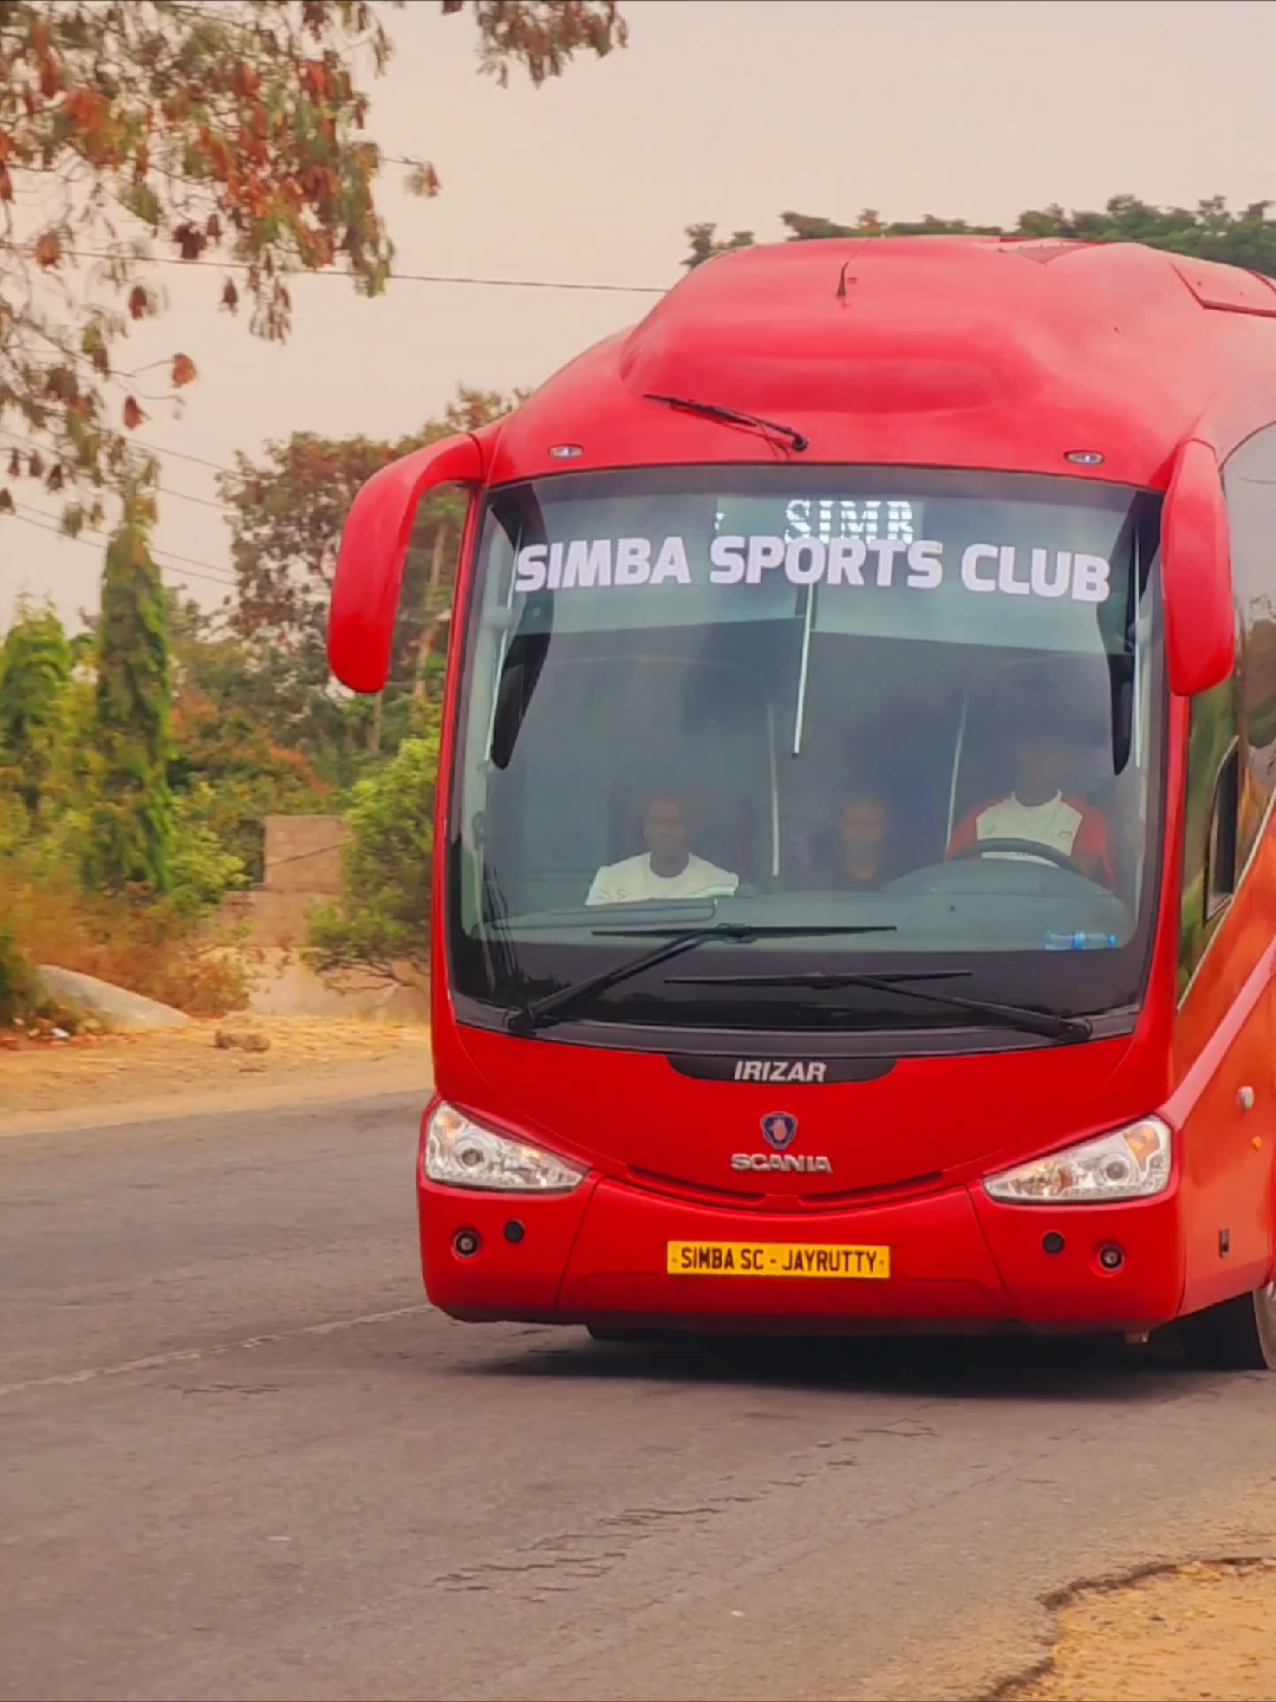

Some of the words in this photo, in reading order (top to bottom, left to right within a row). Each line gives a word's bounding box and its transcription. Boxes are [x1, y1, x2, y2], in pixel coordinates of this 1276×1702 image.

[514, 536, 691, 592] SIMBA
[709, 535, 943, 589] SPORTS
[961, 543, 1111, 603] CLUB
[733, 1060, 827, 1083] IRIZAR
[731, 1152, 833, 1174] SCANIA
[681, 1246, 735, 1270] SIMBA
[740, 1248, 764, 1271] SC
[781, 1250, 878, 1273] JAYRUTTY
